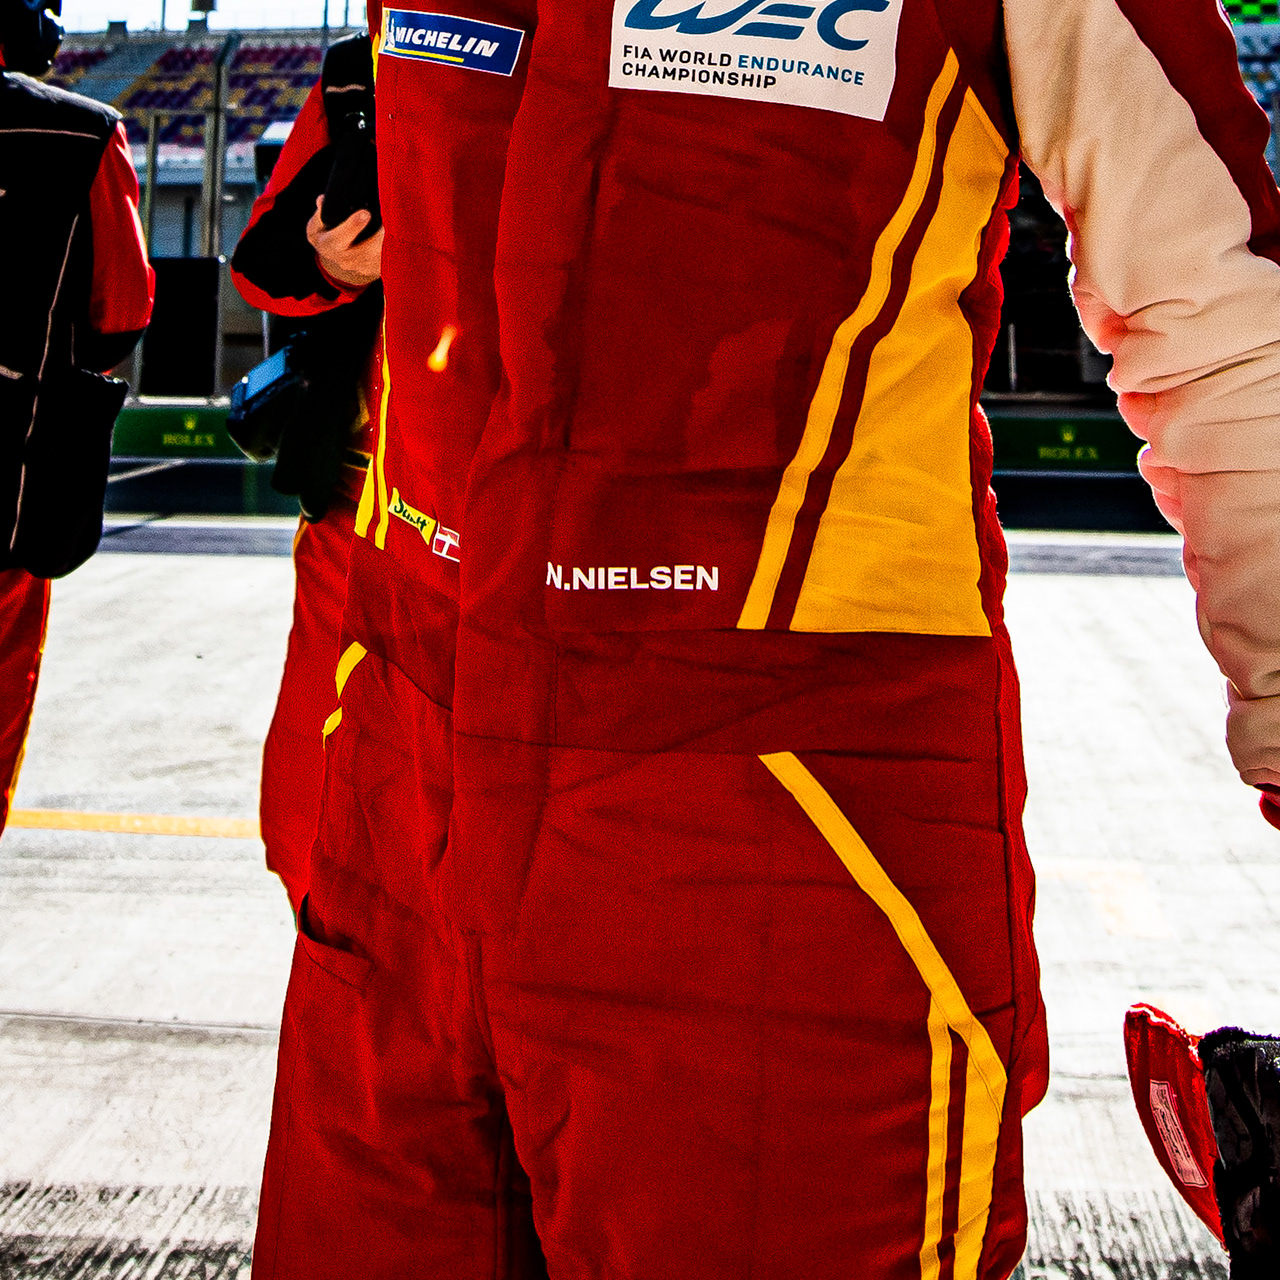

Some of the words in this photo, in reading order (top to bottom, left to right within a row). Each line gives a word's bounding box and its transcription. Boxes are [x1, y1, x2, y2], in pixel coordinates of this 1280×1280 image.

[395, 26, 500, 58] MICHELIN
[621, 62, 778, 90] CHAMPIONSHIP
[622, 44, 653, 61] FIA
[658, 48, 733, 68] WORLD
[737, 54, 866, 86] ENDURANCE
[545, 561, 720, 591] N.NIELSEN
